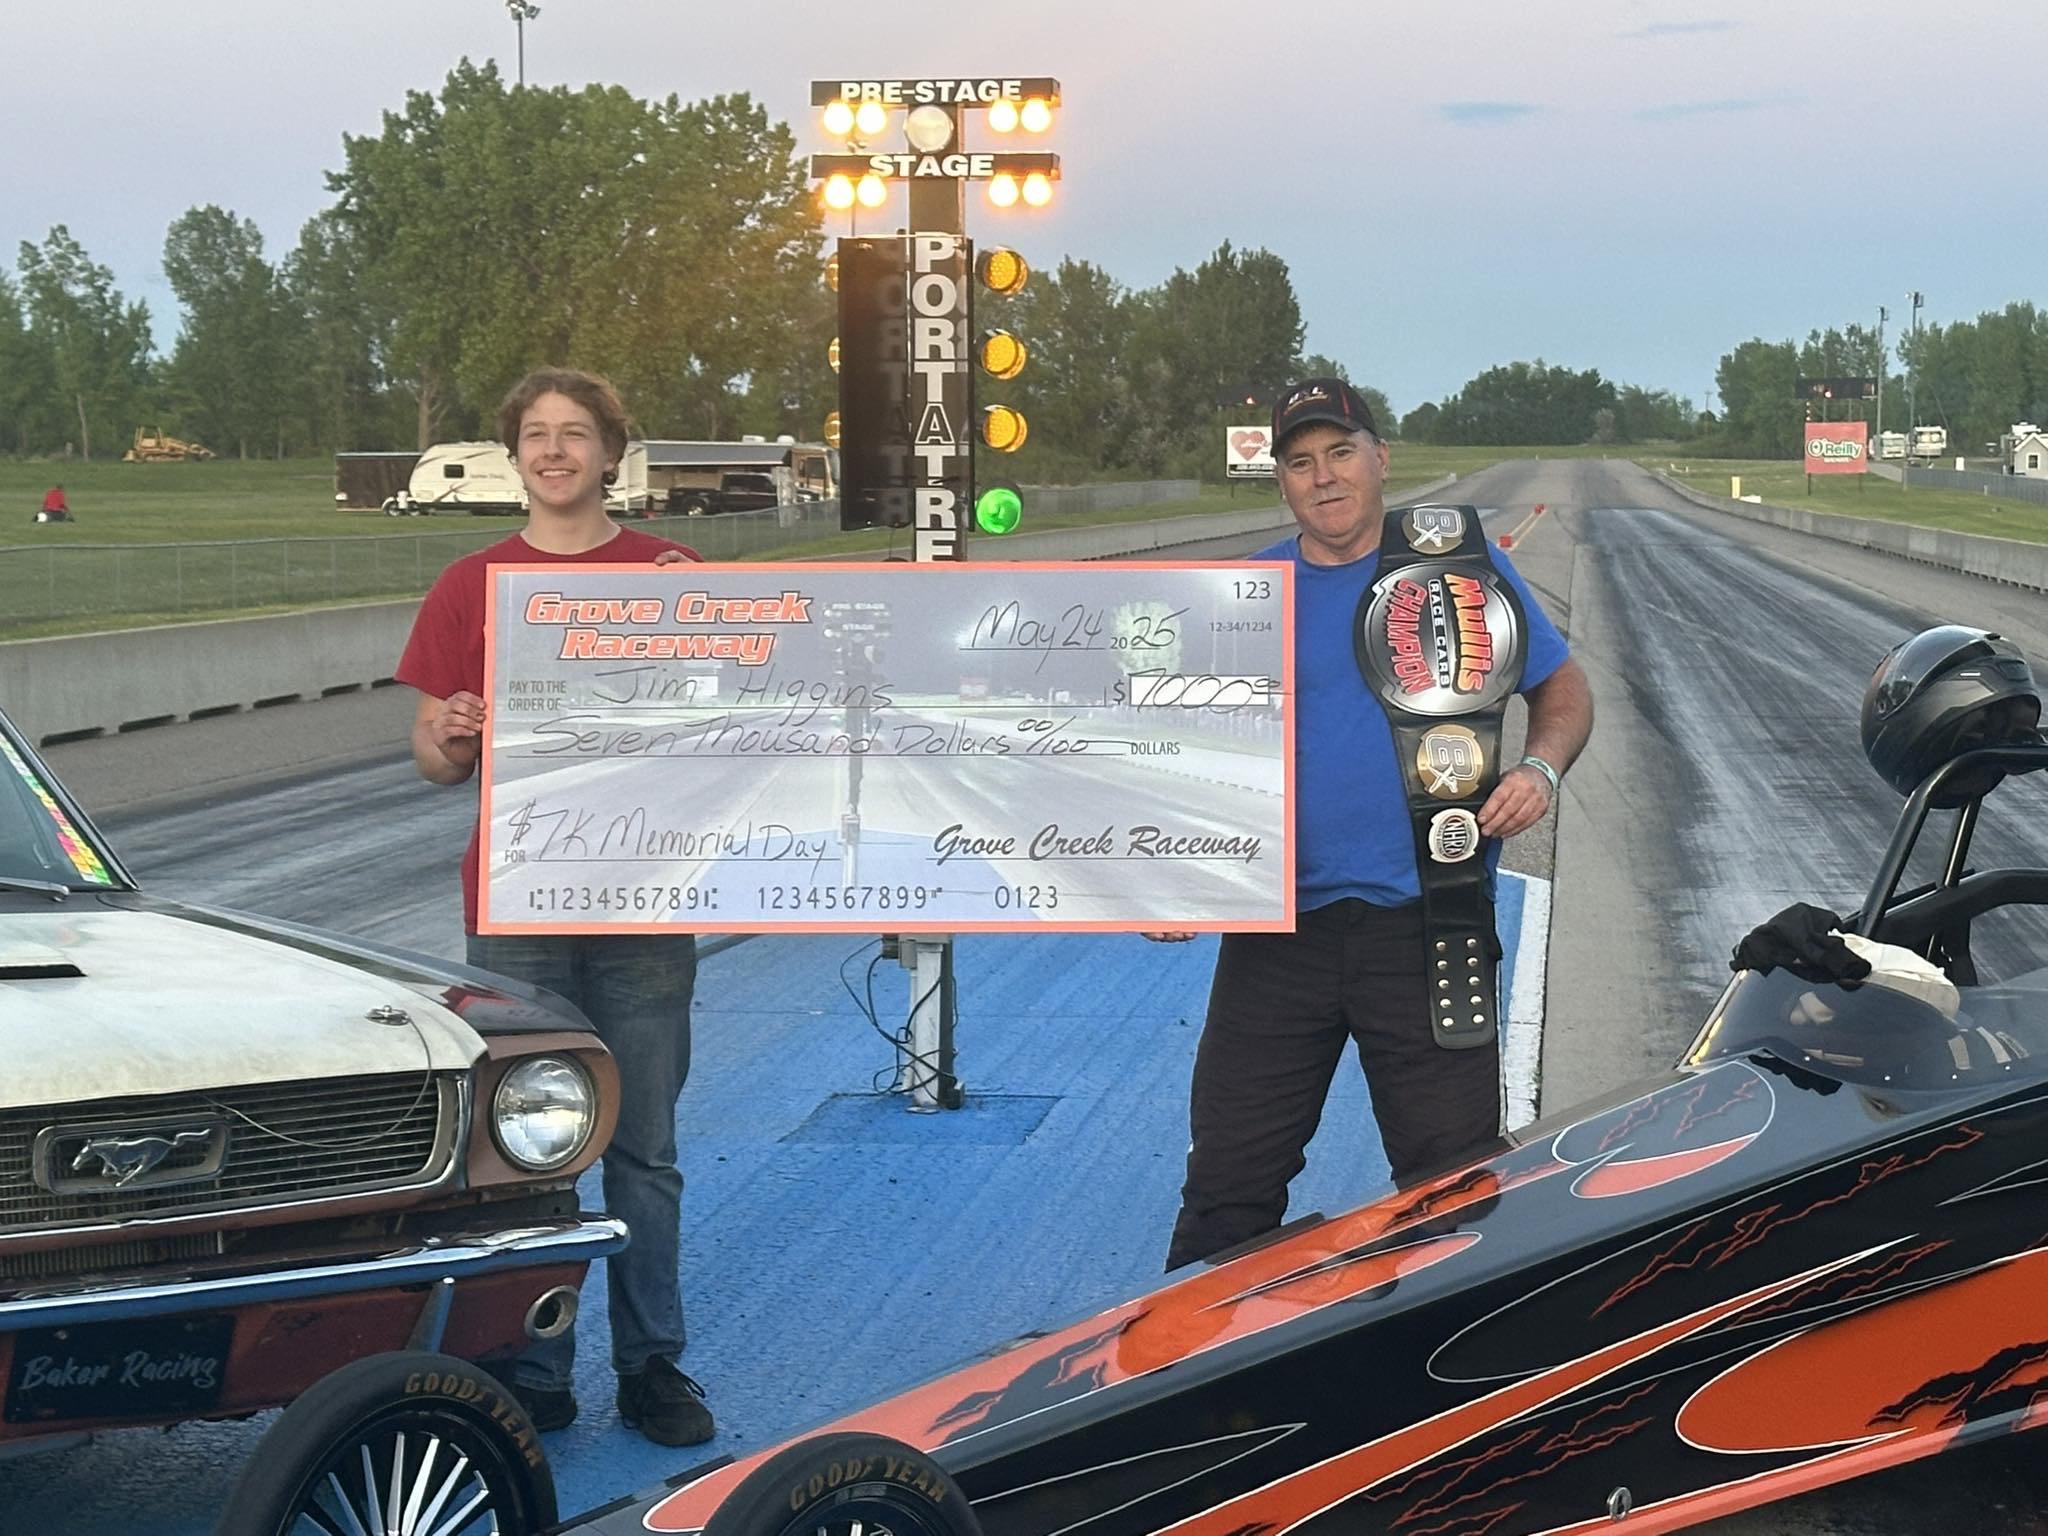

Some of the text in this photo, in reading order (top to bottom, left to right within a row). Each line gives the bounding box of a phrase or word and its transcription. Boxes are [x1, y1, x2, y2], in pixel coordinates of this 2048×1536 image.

[840, 80, 1022, 103] PRE-STAGE
[869, 154, 995, 177] STAGE
[1233, 580, 1271, 600] 123
[524, 591, 814, 624] Grove Creek
[972, 600, 1191, 674] May 24 20 25
[1208, 620, 1273, 633] 12-34/1234
[1386, 577, 1437, 696] CHAMPION
[1429, 580, 1450, 687] RACE CARS
[1443, 573, 1493, 692] Mullis
[556, 626, 779, 666] Raceway
[508, 680, 567, 694] PAY TO THE
[508, 697, 561, 711] ORDER OF
[592, 662, 895, 727] Jim Higgins
[532, 714, 677, 755] Seven
[684, 711, 882, 755] Thousand
[893, 718, 1011, 755] Dollars
[1130, 741, 1181, 756] DOLLARS
[599, 806, 752, 858] Memorial
[760, 824, 827, 885] Day
[934, 823, 1262, 866] Grove Creek Raceway
[1443, 821, 1467, 855] NHRA
[504, 849, 526, 863] FOR
[995, 886, 1059, 909] 0123
[19, 1350, 218, 1390] Baker Racing
